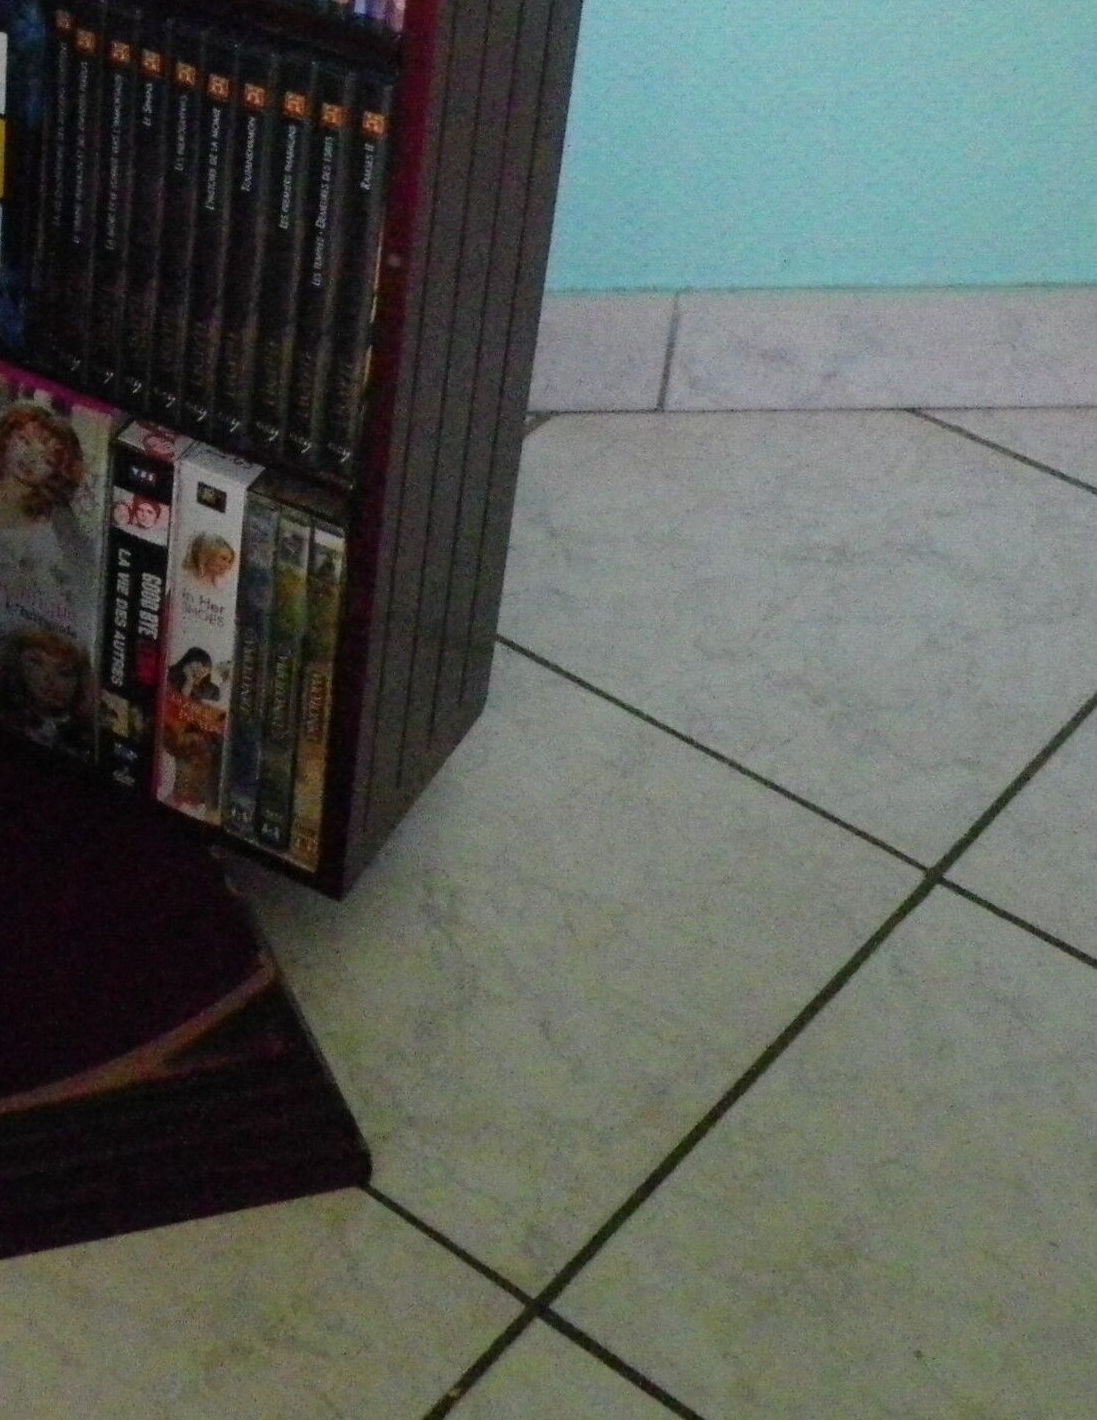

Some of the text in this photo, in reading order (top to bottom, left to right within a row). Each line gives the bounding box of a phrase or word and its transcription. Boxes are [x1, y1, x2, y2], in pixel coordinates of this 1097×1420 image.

[139, 572, 162, 611] GOOD
[110, 548, 131, 687] LA VIE DES AUTRES
[137, 610, 158, 639] BYE
